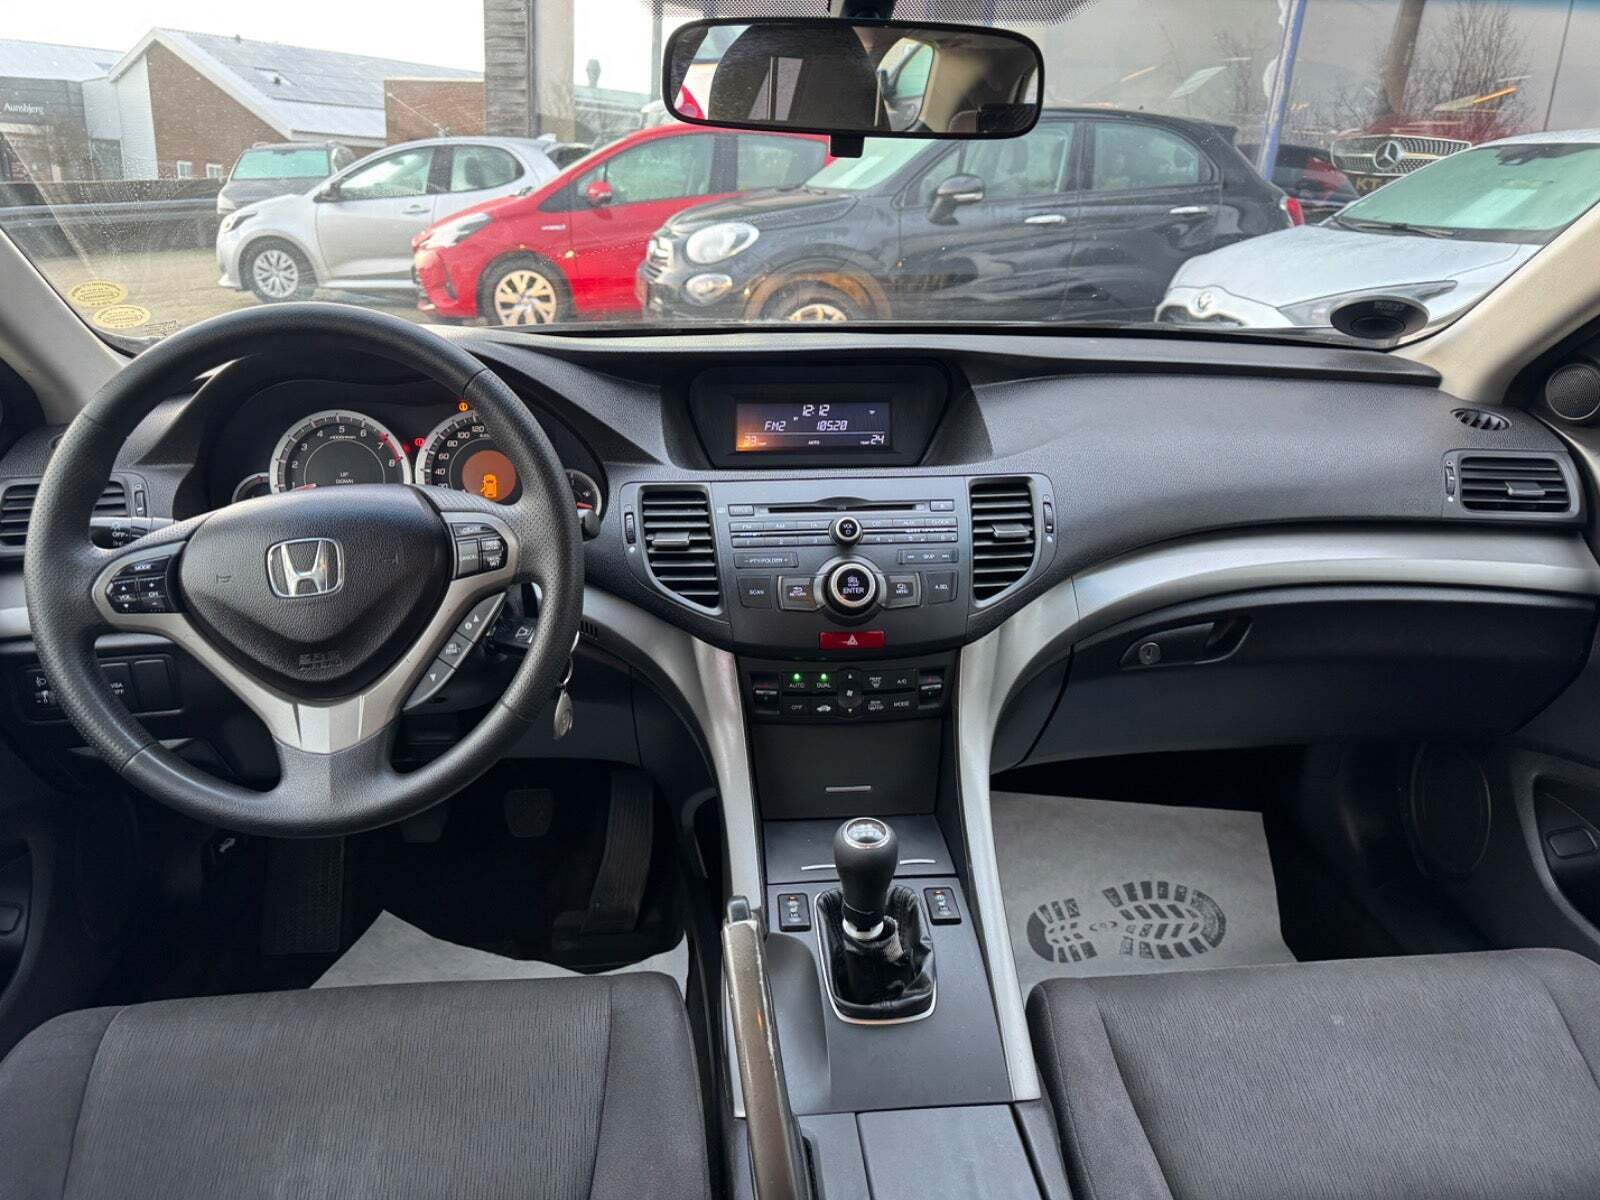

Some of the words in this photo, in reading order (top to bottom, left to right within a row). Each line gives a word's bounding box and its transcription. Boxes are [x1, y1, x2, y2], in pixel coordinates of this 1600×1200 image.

[338, 425, 345, 434] 5
[471, 425, 485, 433] 120
[764, 420, 786, 431] FM2
[316, 429, 324, 438] 4
[360, 429, 367, 438] 6
[457, 431, 470, 439] 100
[446, 439, 459, 448] 80
[870, 434, 885, 445] 24
[301, 442, 308, 451] 3
[378, 441, 384, 450] 7
[438, 452, 450, 461] 60
[291, 460, 299, 469] 2
[388, 458, 396, 468] 8
[434, 468, 446, 476] 40
[842, 586, 866, 595] ENTER
